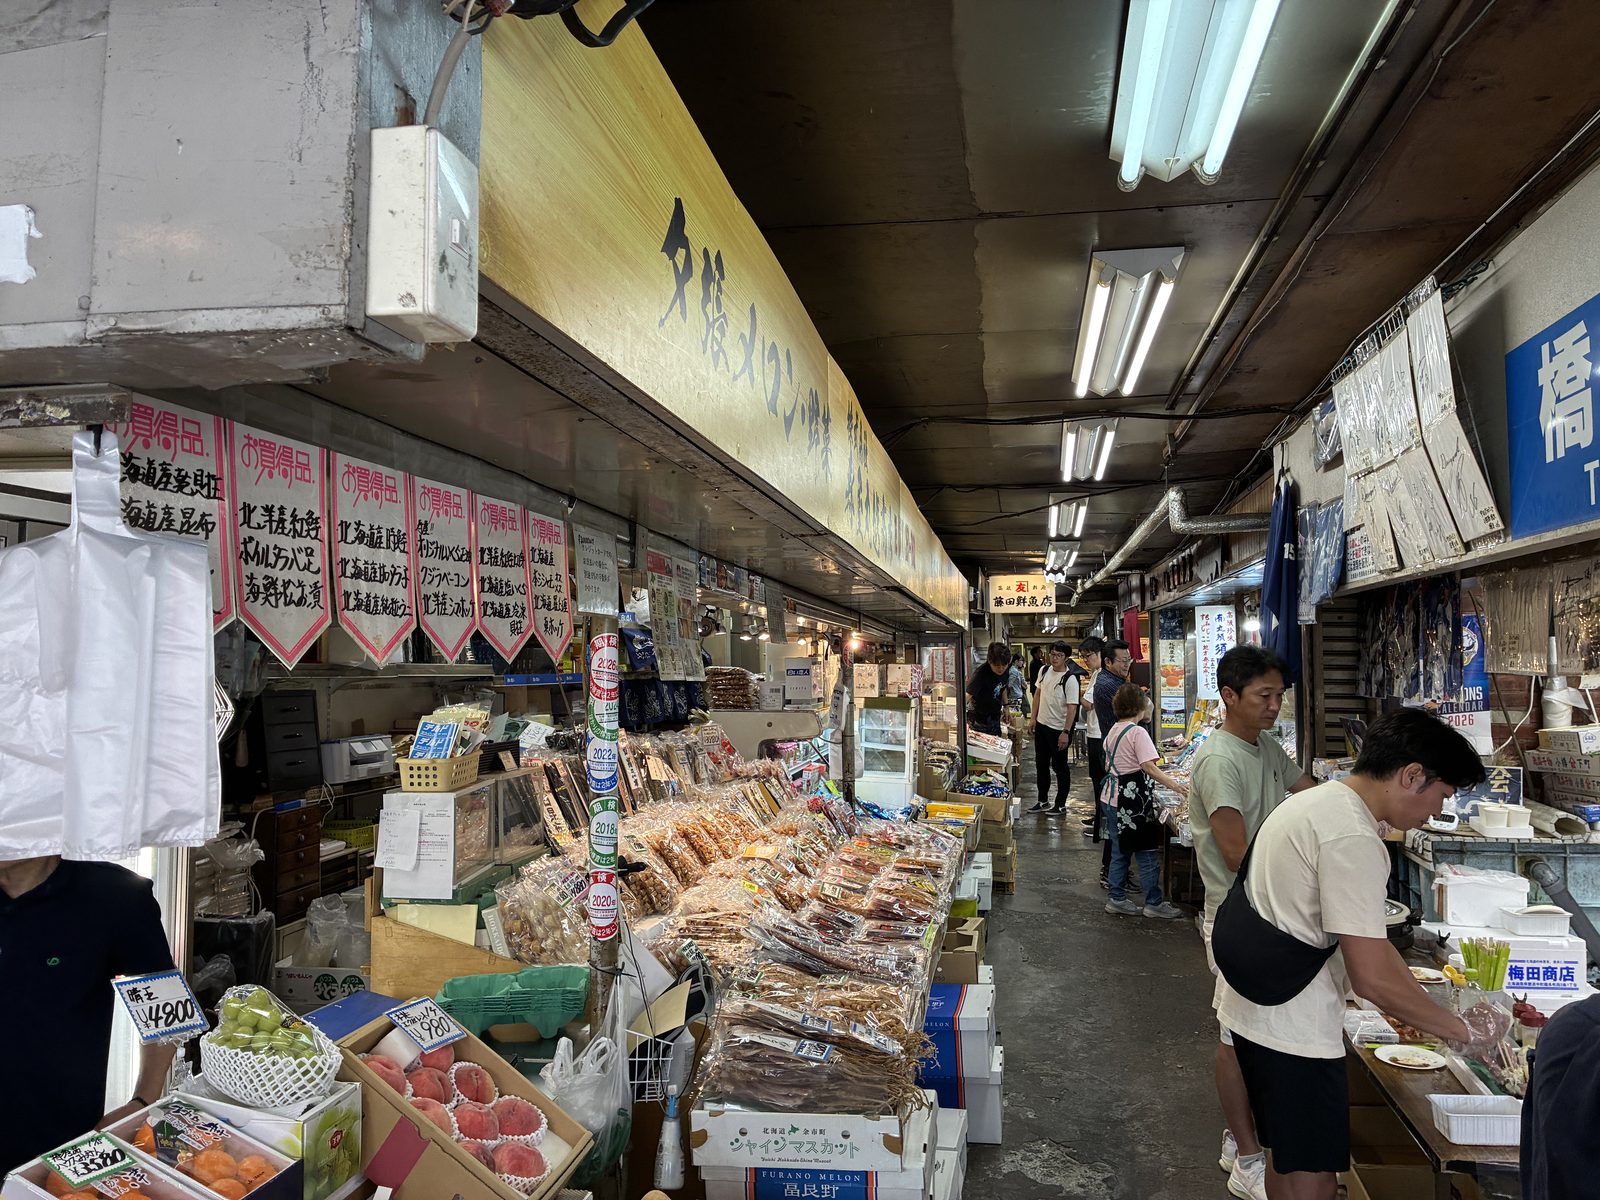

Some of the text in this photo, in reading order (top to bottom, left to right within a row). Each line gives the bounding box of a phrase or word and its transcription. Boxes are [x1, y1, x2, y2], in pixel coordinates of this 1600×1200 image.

[1537, 320, 1594, 464] 橋
[121, 497, 215, 539] 海道産昆布
[239, 535, 321, 575] ボイルタラバ足
[420, 566, 470, 588] クジラベーコン
[993, 595, 1053, 607] 藤田鮮魚店
[1436, 701, 1483, 714] CALENDAR
[1448, 714, 1474, 726] 2026
[1508, 965, 1575, 982] 梅田商店
[126, 986, 159, 1003] 晴王
[763, 1127, 827, 1136] 北海道 余市町
[730, 1137, 861, 1159] シャインマスカット
[762, 1170, 861, 1182] FURANO MELON
